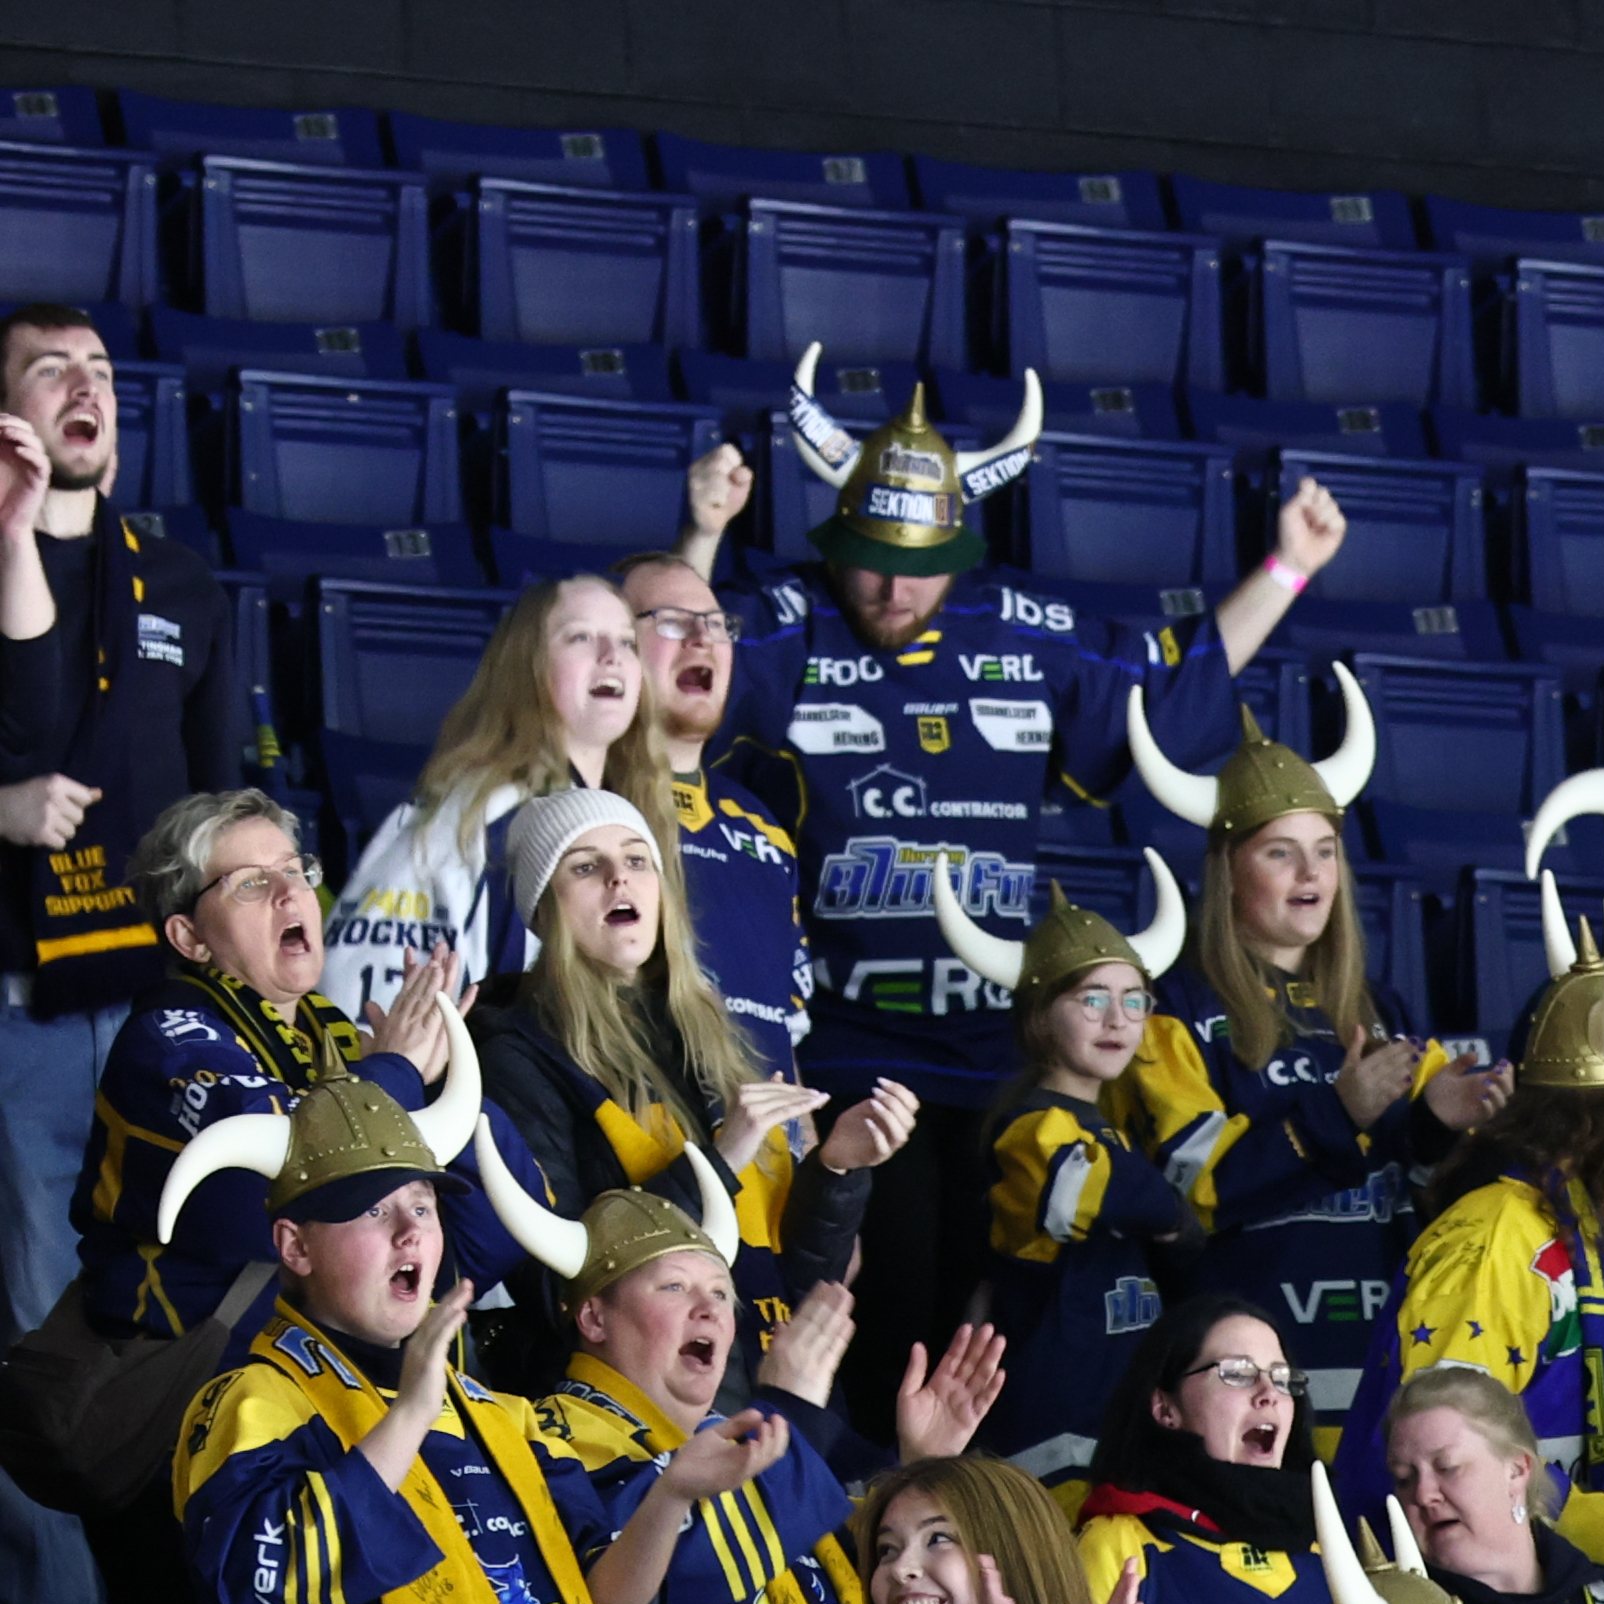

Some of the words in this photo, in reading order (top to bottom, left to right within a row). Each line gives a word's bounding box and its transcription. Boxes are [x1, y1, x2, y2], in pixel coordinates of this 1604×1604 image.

[49, 846, 106, 875] BLUE
[61, 869, 107, 893] FOX
[45, 886, 136, 917] SUPPORT
[322, 918, 459, 952] HOCKEY
